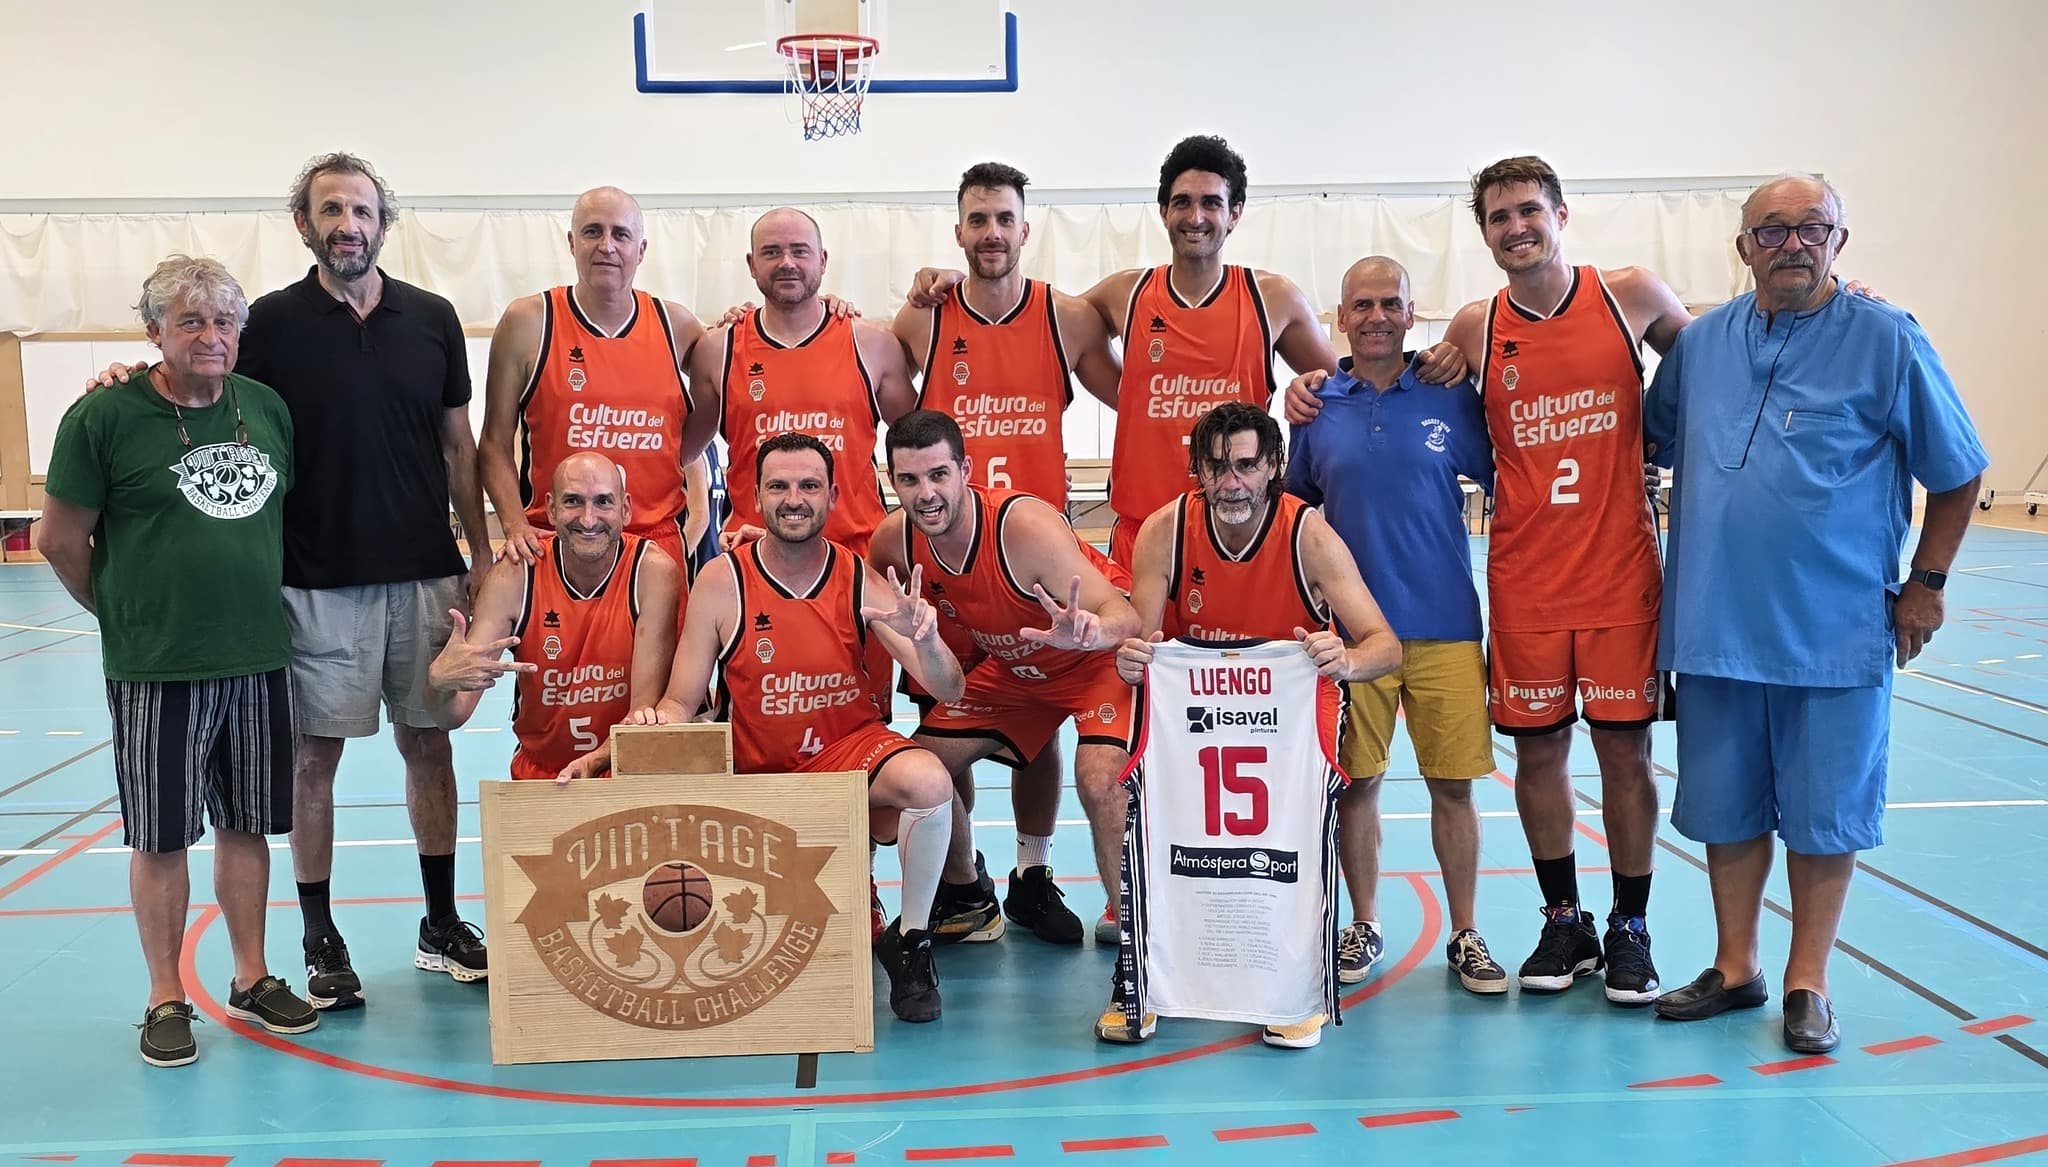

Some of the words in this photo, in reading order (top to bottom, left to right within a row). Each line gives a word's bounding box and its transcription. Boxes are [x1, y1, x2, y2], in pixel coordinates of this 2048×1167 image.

[1150, 374, 1226, 396] Cultura
[569, 403, 647, 427] Cultura
[647, 416, 664, 428] del
[953, 393, 1027, 416] Cultura
[1028, 401, 1046, 412] del
[1147, 396, 1240, 418] Esfue
[1510, 389, 1595, 423] Cultura
[1597, 390, 1616, 406] del
[755, 410, 828, 434] Cultura
[829, 417, 845, 429] del
[1513, 410, 1618, 448] Esfuerzo
[567, 425, 663, 450] Esfuerzo
[1551, 458, 1580, 504] 2
[186, 486, 241, 517] BASKETBALL
[241, 475, 276, 515] CHALLENGE
[606, 667, 624, 680] del
[761, 672, 842, 694] Cultura
[843, 675, 857, 686] de
[1188, 667, 1272, 696] LUENGO
[760, 688, 860, 716] Esfuerzo
[1509, 684, 1566, 700] PULEVA
[1585, 684, 1636, 700] Midea
[1216, 707, 1278, 726] isaval
[569, 716, 598, 751] 5
[798, 727, 824, 756] 4
[1198, 746, 1269, 836] 15
[566, 813, 784, 880] VIN'T'AGE
[1173, 850, 1247, 876] Atmósfera
[1250, 851, 1297, 878] Sport
[537, 927, 686, 1025] BASKETBALL
[695, 920, 819, 1022] CHALLENGE
